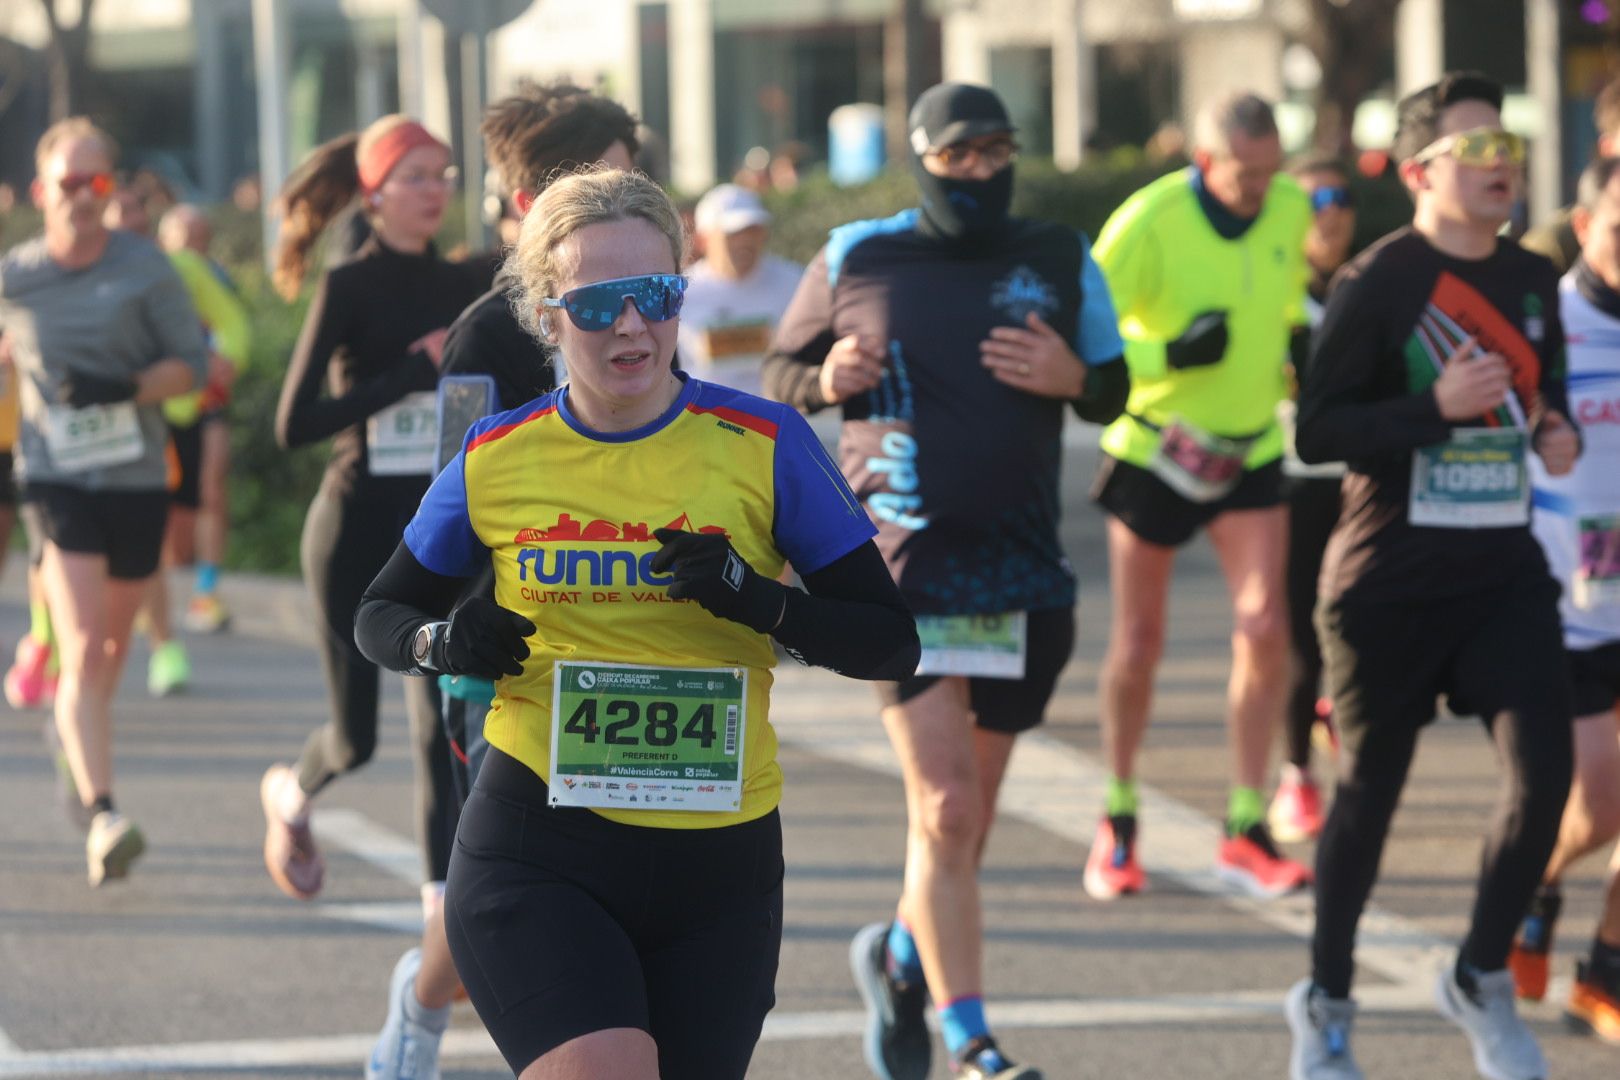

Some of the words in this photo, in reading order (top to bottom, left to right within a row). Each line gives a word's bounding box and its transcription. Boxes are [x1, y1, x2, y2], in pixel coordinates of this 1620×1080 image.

[517, 548, 675, 586] runne
[521, 587, 582, 604] CIUTAT
[592, 591, 621, 603] DE
[631, 591, 699, 603] VAL
[564, 698, 717, 748] 4284
[622, 751, 670, 761] PREFERENT
[672, 753, 678, 761] D
[610, 766, 679, 777] #ValènciaCorre
